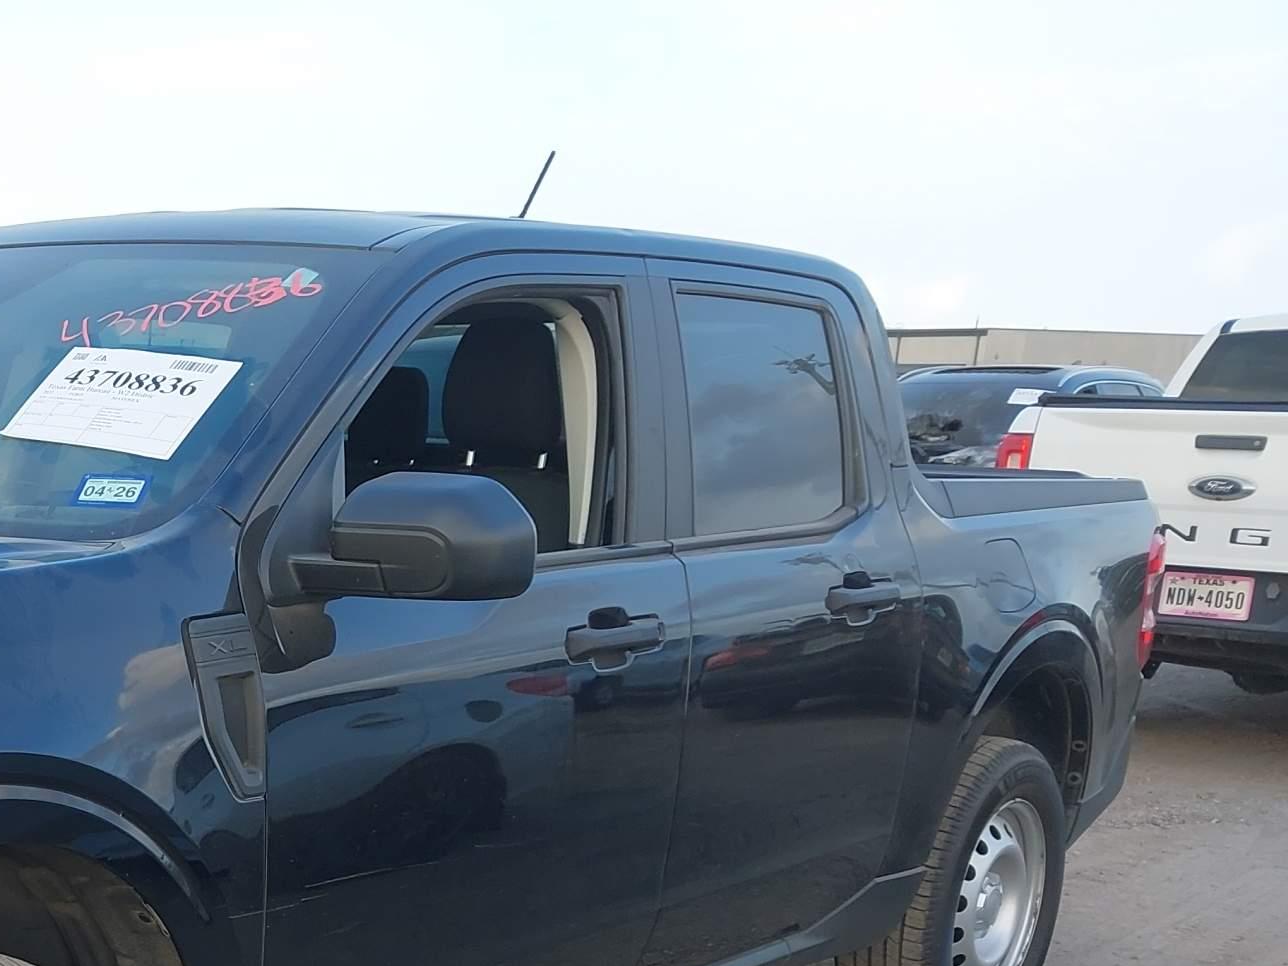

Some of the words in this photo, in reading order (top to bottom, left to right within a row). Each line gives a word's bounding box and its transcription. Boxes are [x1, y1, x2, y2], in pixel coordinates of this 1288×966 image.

[64, 368, 204, 397] 43708836
[1204, 480, 1234, 493] Ford
[1192, 577, 1225, 587] TEXAS
[208, 639, 247, 655] XL
